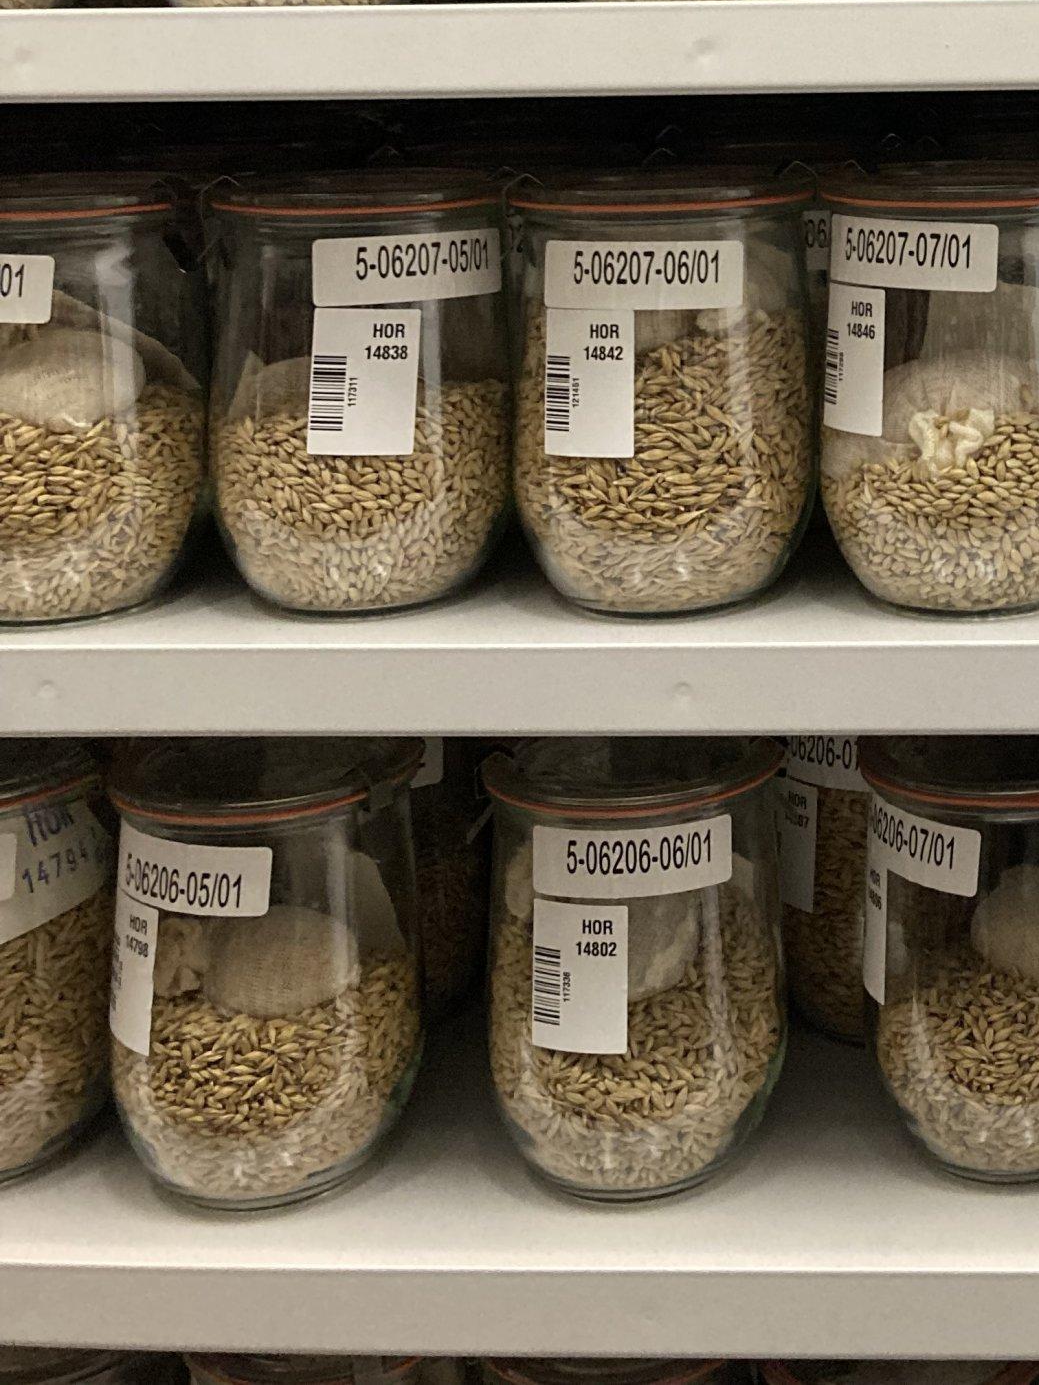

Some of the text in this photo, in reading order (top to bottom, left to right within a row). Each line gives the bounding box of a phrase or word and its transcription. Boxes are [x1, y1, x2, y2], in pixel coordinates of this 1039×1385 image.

[845, 227, 972, 269] 5-06207-07/01
[356, 241, 489, 282] 5-06207-05/01
[573, 248, 721, 287] 5-06207-06/01
[851, 300, 873, 318] HOR
[372, 322, 405, 339] HOR
[589, 324, 620, 340] HOR
[846, 323, 875, 340] 14846
[364, 345, 408, 361] 14838
[582, 345, 624, 362] 14842
[566, 829, 713, 875] 5-06206-06/01
[125, 851, 242, 909] 5-06206-05/01
[129, 914, 148, 935] HOR
[581, 919, 614, 935] HOR
[575, 940, 618, 957] 14802
